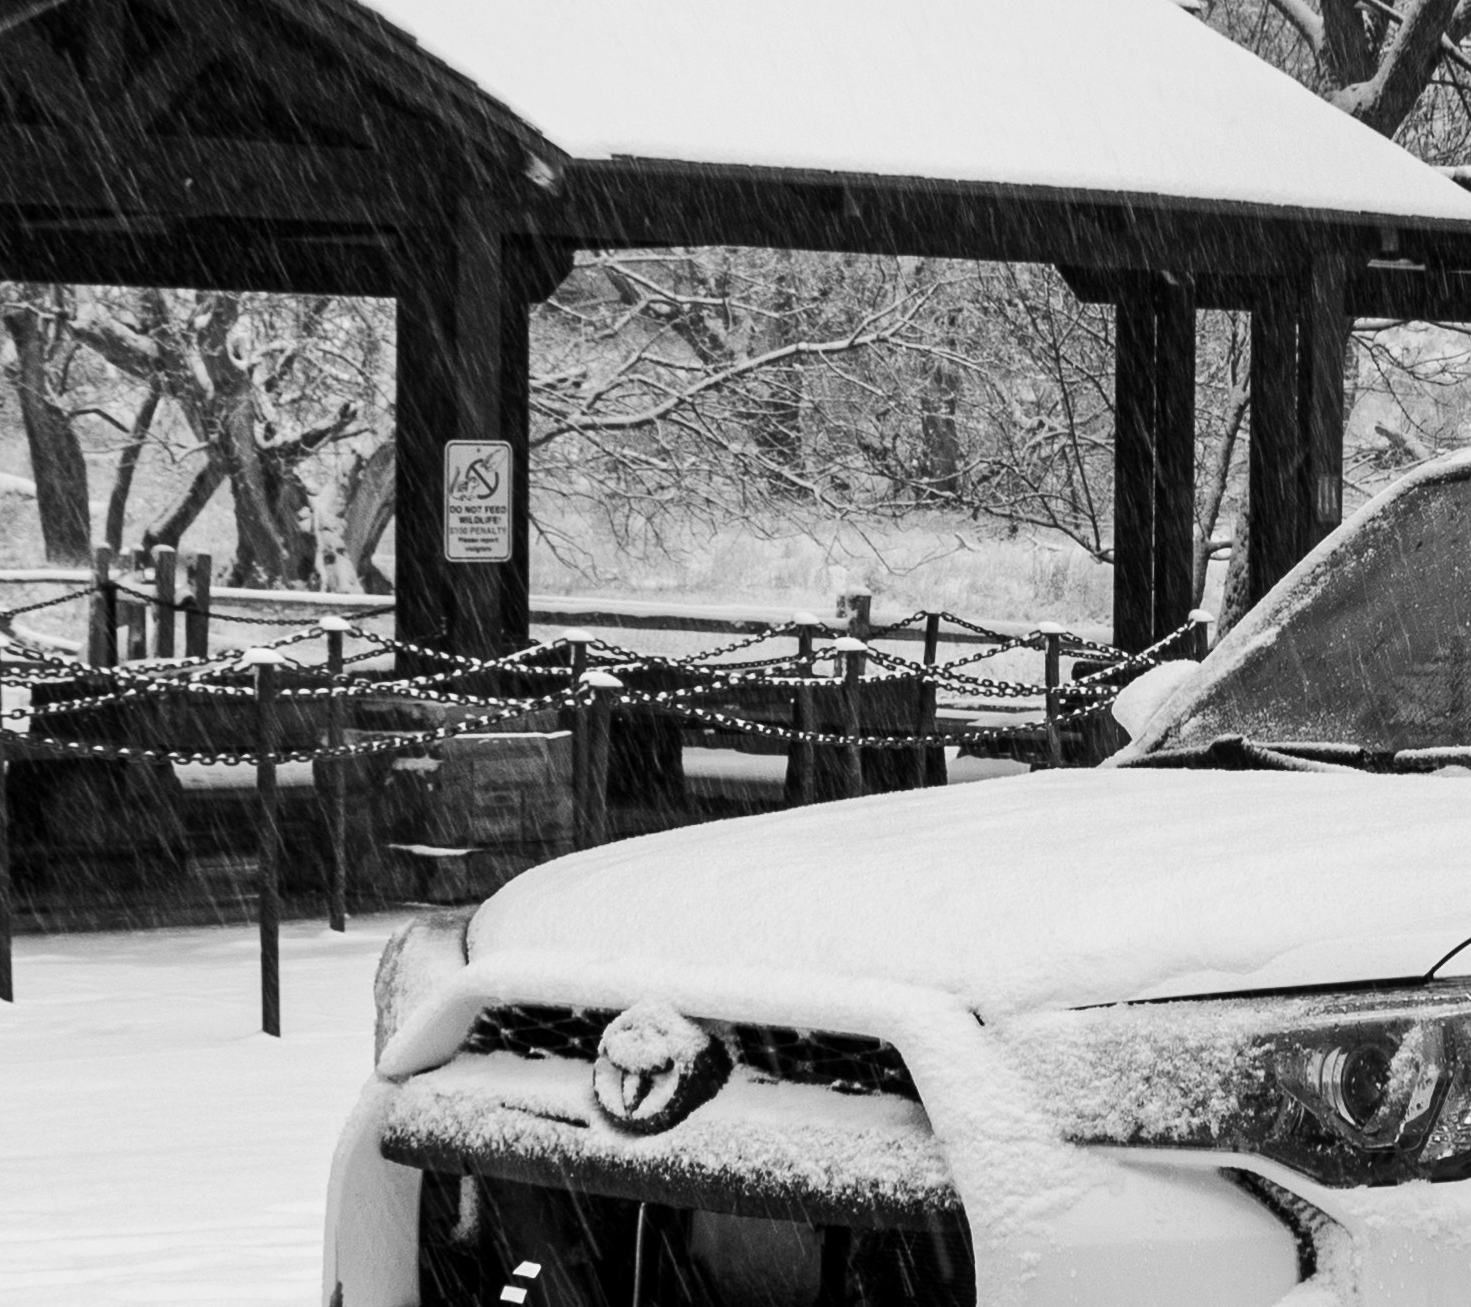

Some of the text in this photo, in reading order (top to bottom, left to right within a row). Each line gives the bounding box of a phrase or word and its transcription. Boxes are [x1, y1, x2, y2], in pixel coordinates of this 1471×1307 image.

[449, 505, 507, 514] DO NOT FEED
[470, 526, 507, 535] PENALTY
